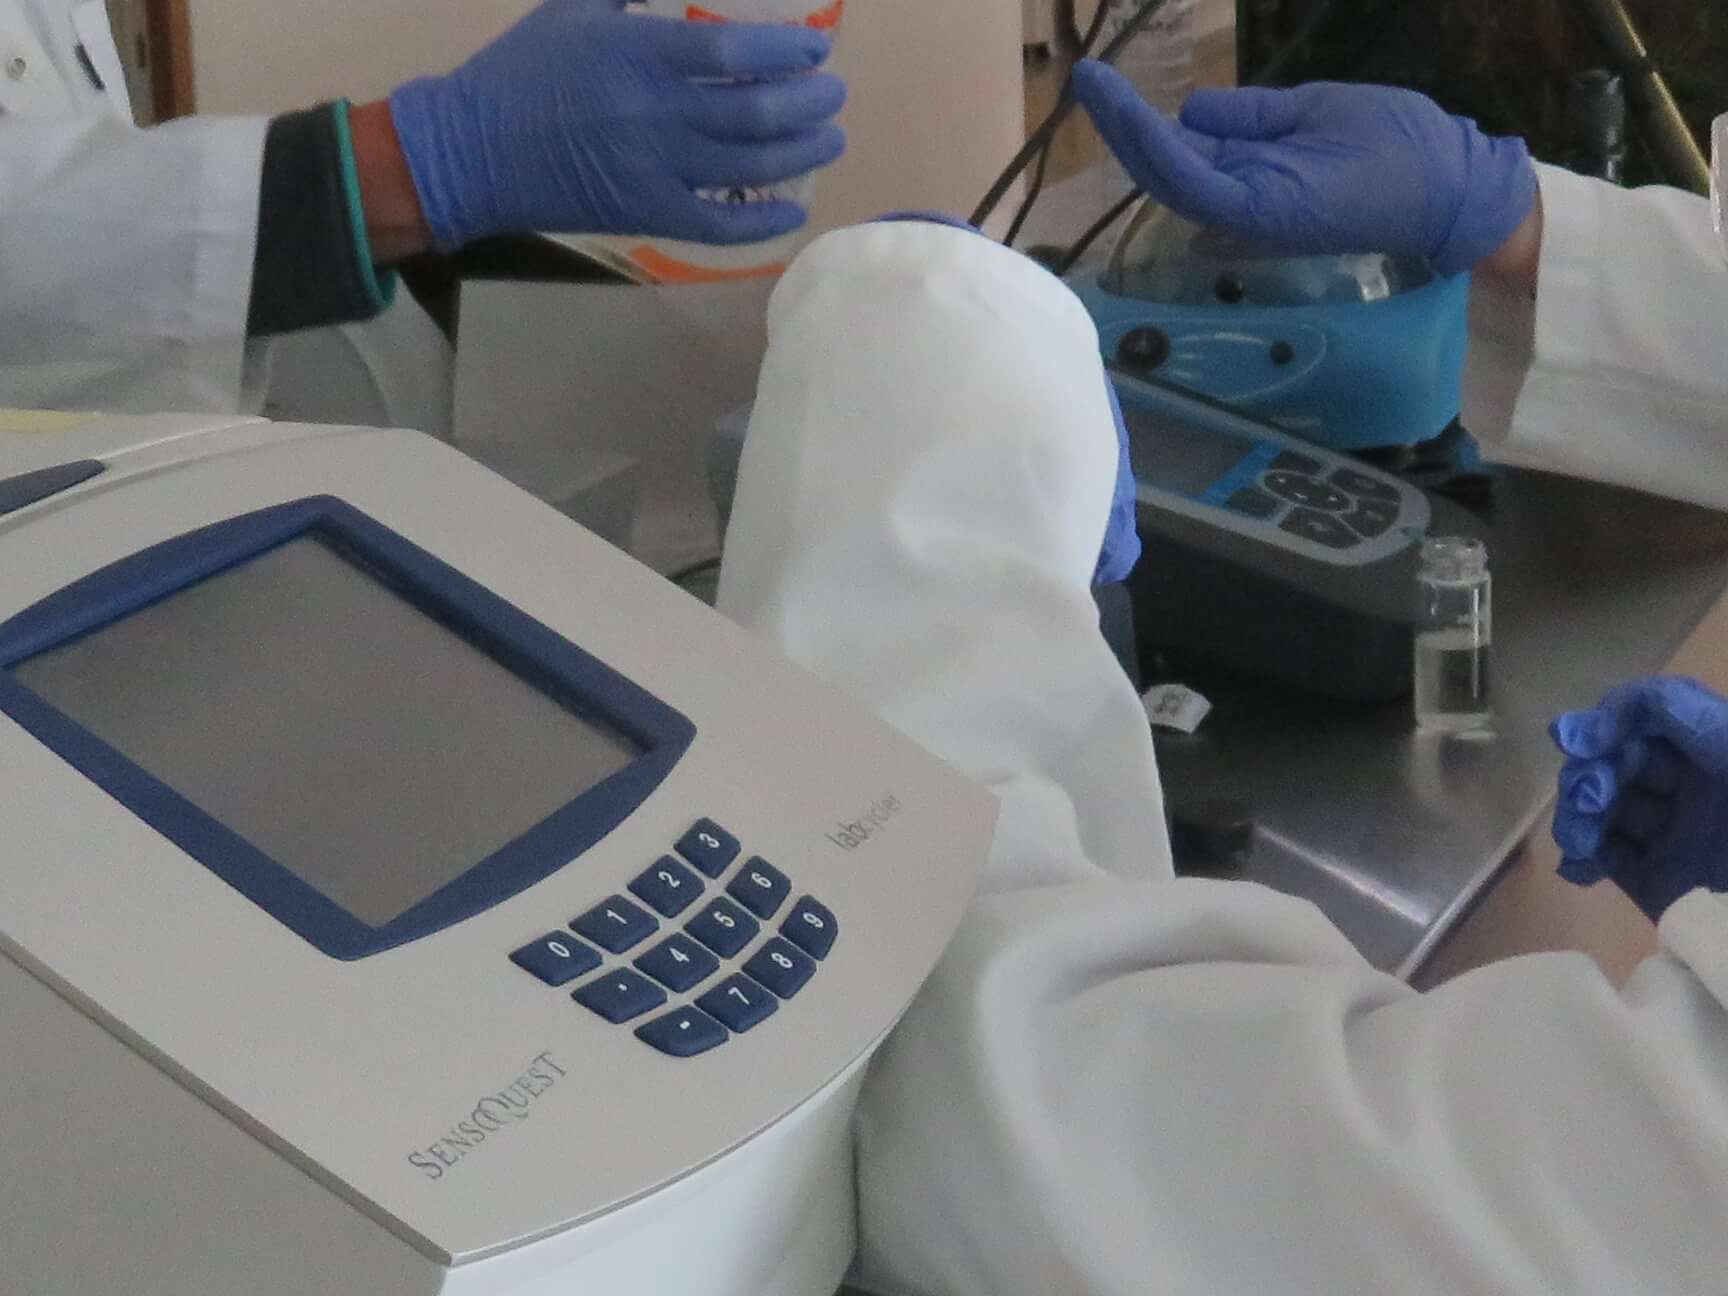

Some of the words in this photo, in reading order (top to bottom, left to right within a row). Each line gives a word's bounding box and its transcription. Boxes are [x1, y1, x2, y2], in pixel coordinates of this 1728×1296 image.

[547, 941, 571, 958] 0
[607, 908, 628, 925] 1
[657, 871, 681, 889] 2
[698, 832, 721, 849] 3
[669, 947, 691, 964] 4
[713, 910, 736, 929] 5
[750, 871, 773, 889] 6
[727, 987, 751, 1005] 7
[770, 952, 793, 969] 8
[802, 911, 824, 929] 9
